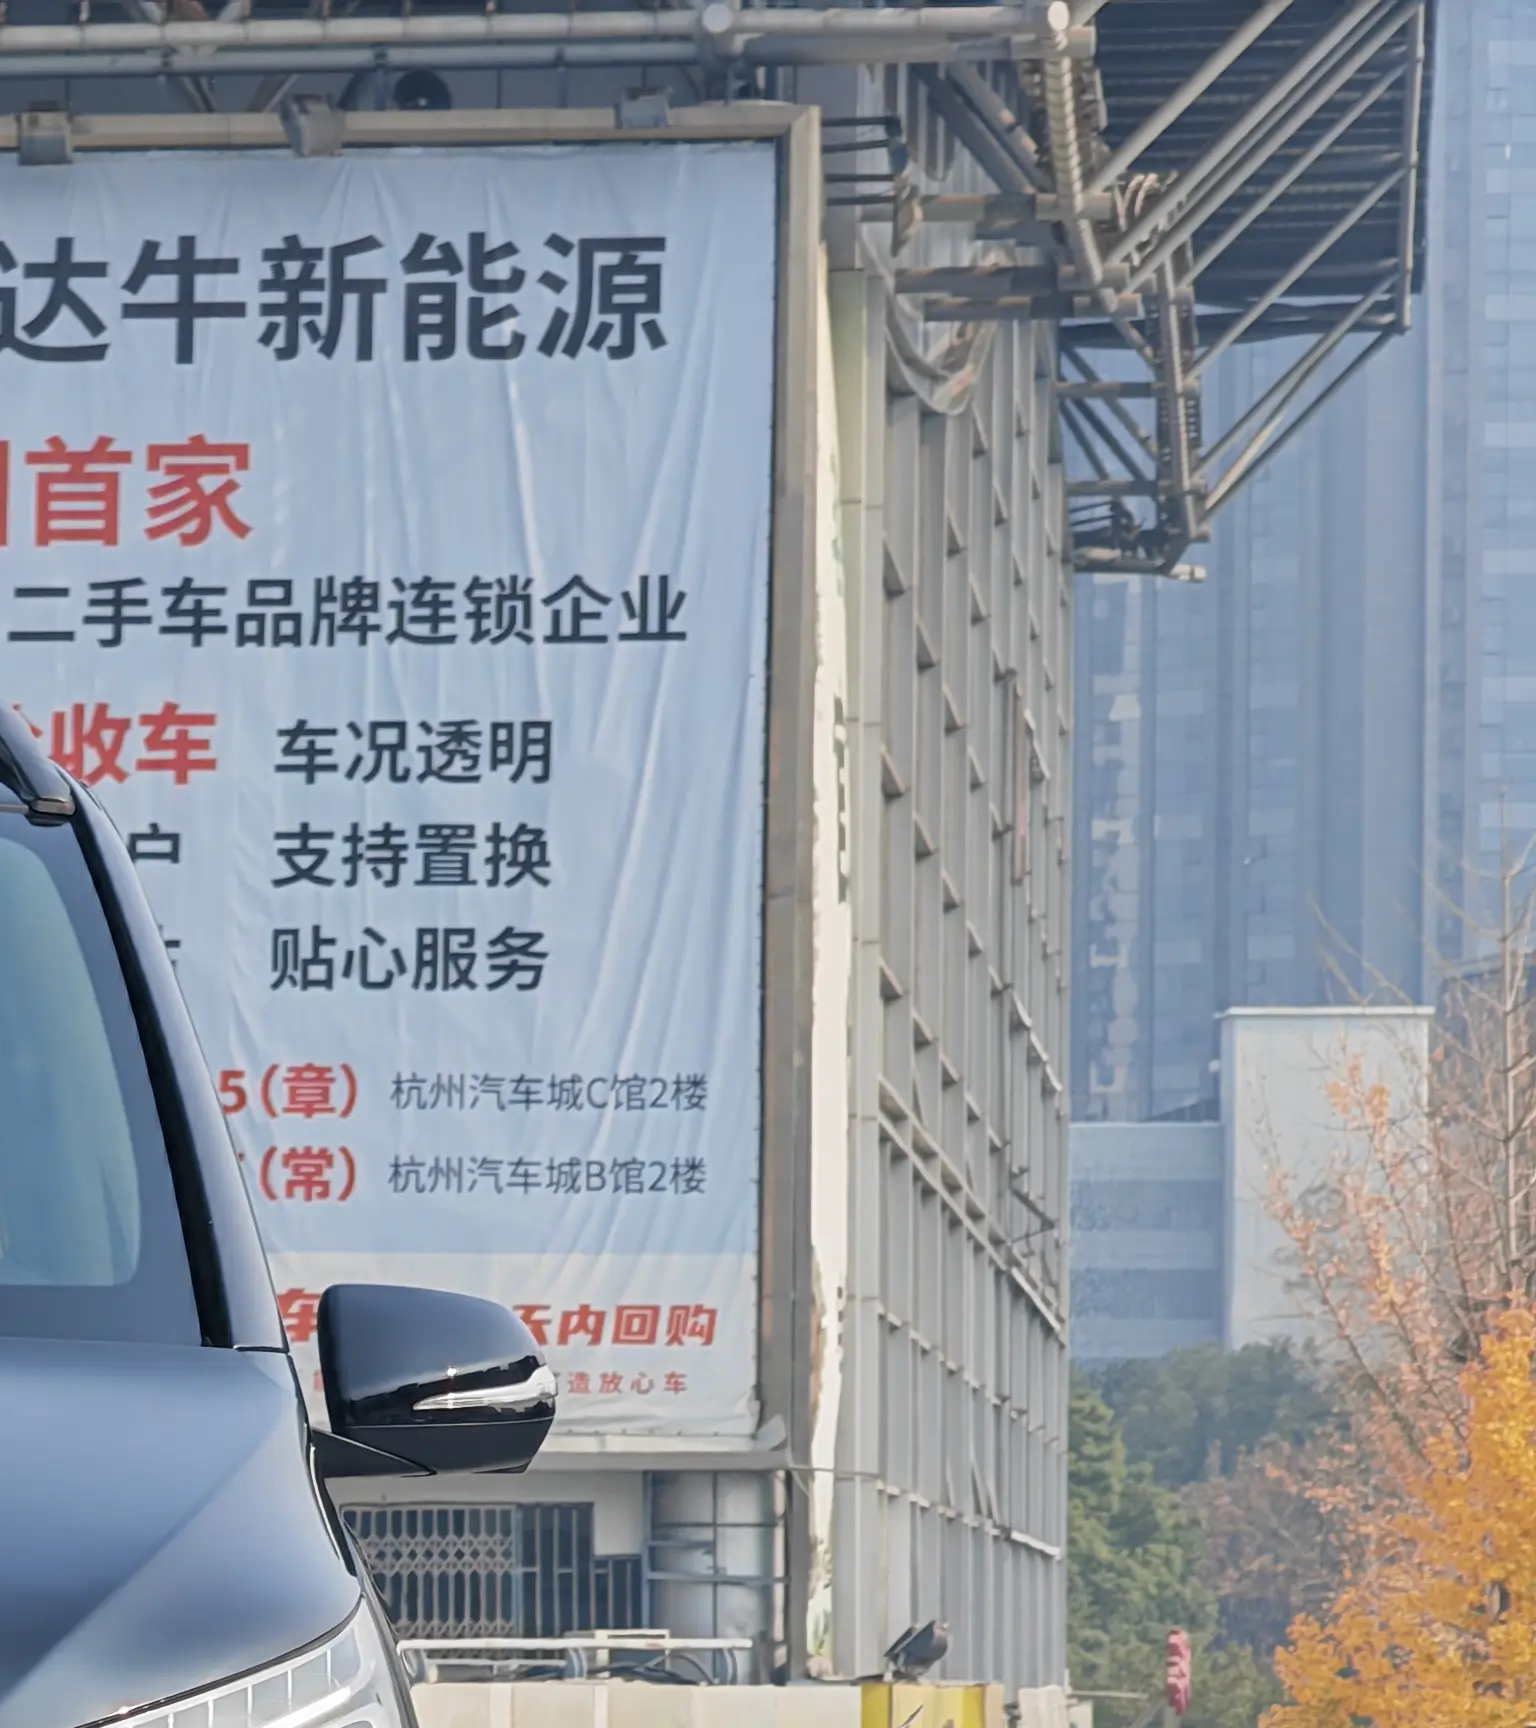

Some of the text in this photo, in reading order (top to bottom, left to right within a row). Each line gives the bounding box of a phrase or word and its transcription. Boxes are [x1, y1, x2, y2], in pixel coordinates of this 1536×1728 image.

[6, 574, 688, 650] 二手车品牌连锁企业
[273, 719, 553, 786] 车况透明
[270, 822, 552, 890] 支持置换
[269, 924, 550, 992] 贴心服务
[390, 1072, 708, 1111] 杭州汽车城C馆2楼
[238, 1146, 706, 1202] (常) 杭州汽车城B馆2楼
[556, 1372, 688, 1394] 造放心车
